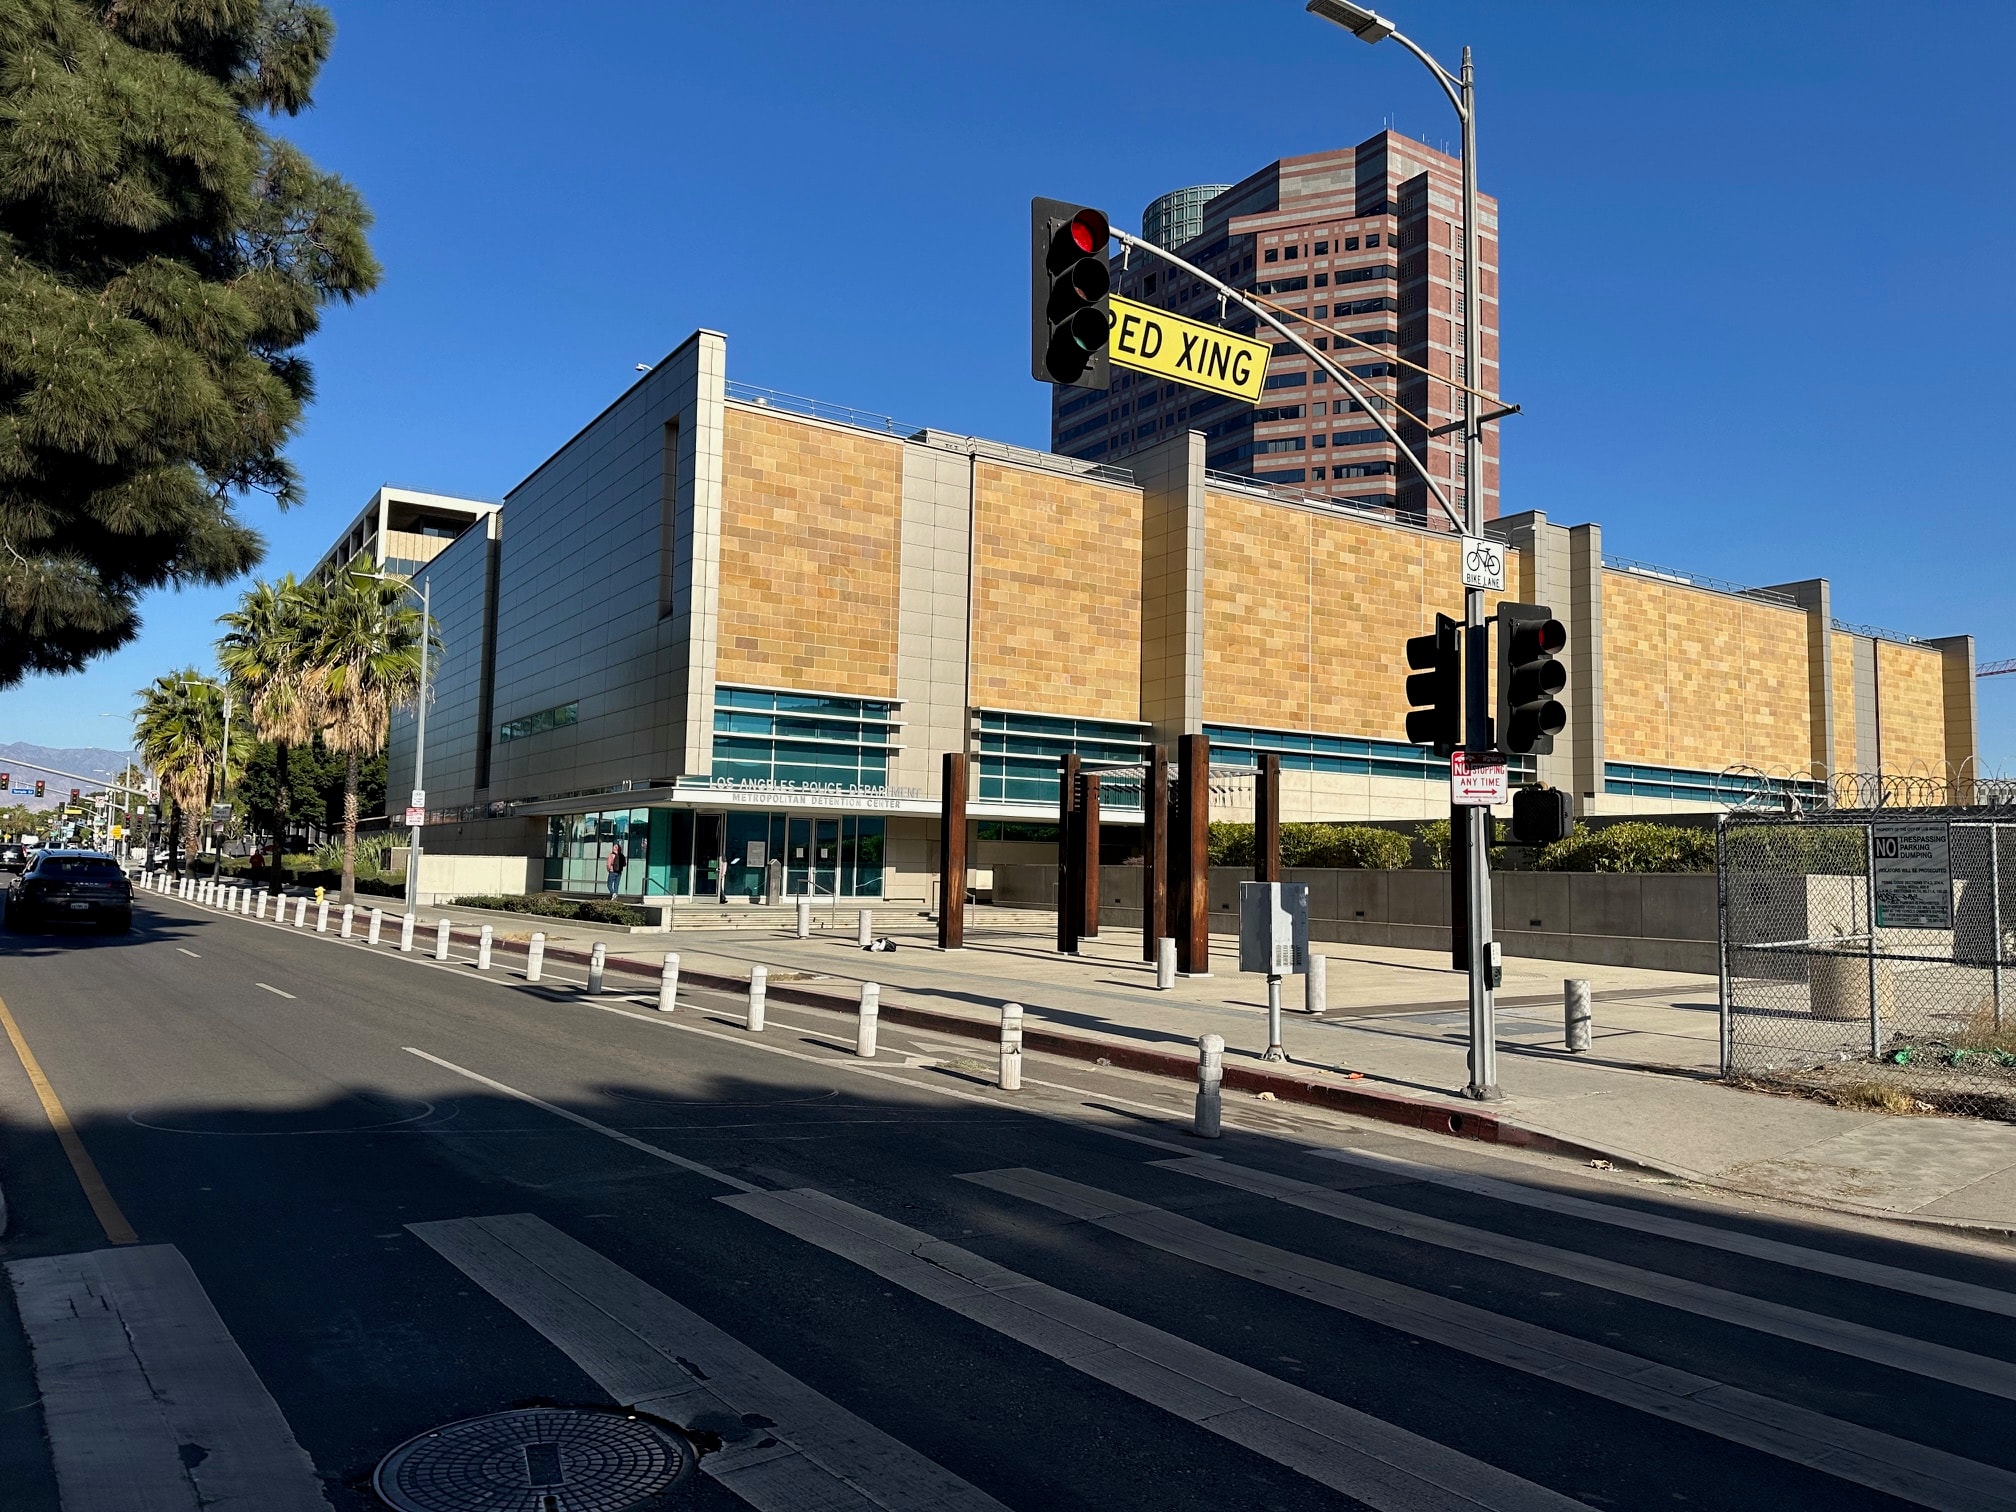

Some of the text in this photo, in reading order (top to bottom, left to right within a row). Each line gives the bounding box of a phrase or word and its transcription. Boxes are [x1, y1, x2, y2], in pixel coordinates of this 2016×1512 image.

[1175, 332, 1252, 386] XING
[1467, 573, 1500, 588] BIKE LANE
[1454, 763, 1505, 775] NO STOPPING
[709, 777, 921, 799] LOS ANGELES POLICE DEPARTMENT
[1460, 777, 1500, 787] ANY TIME
[732, 793, 901, 808] METROPOLITAN DETENTION CENTER
[1875, 838, 1897, 857] NO
